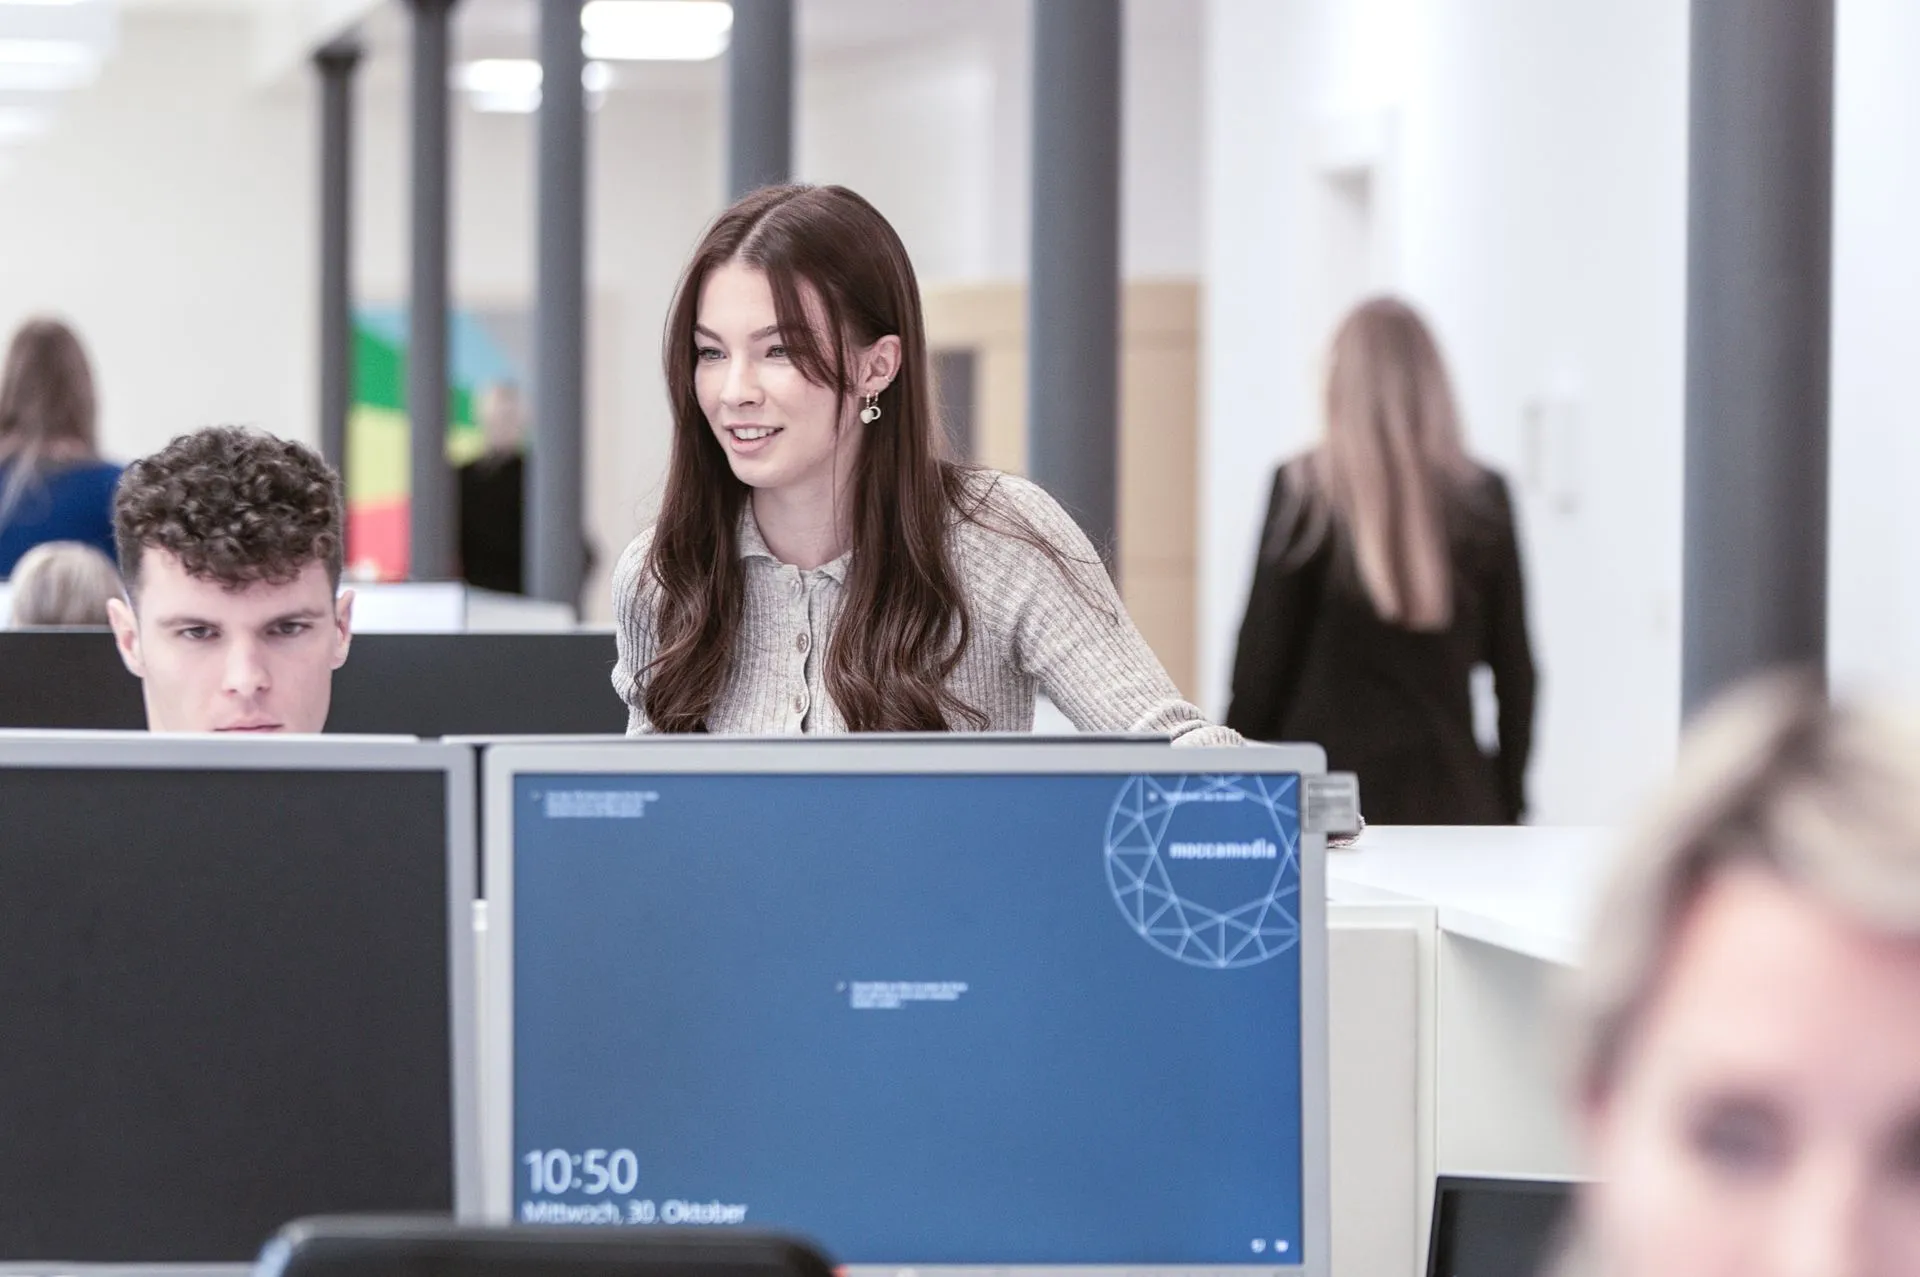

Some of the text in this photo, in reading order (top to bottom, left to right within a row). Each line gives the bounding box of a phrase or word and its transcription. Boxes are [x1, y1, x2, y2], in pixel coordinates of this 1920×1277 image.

[1169, 838, 1277, 859] moccamedia
[524, 1148, 638, 1195] 10:50
[522, 1199, 748, 1226] Mittwoch, 30. Oktober
